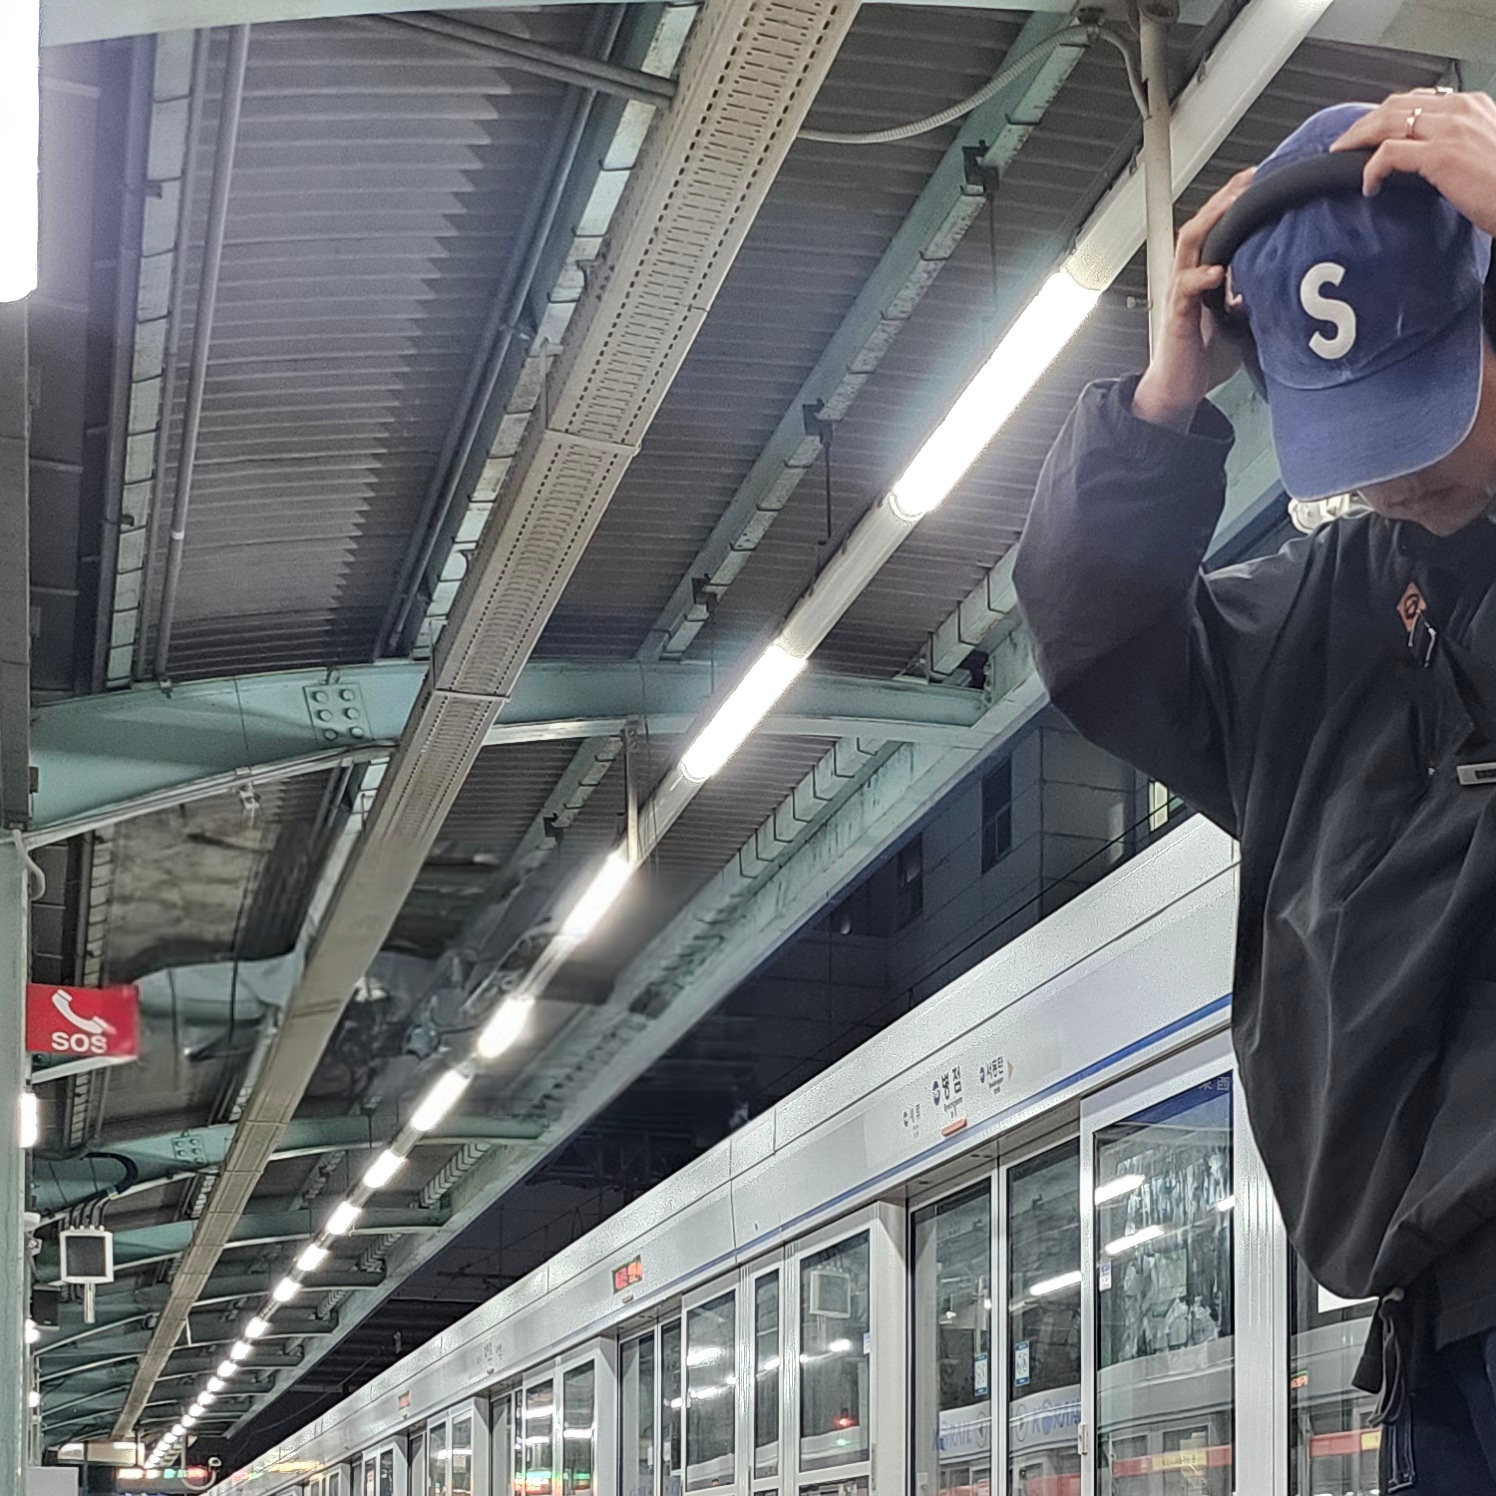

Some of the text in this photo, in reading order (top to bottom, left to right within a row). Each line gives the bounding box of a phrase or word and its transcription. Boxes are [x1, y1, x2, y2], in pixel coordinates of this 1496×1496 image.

[1300, 261, 1357, 360] S
[51, 1031, 108, 1054] SOS
[941, 1065, 963, 1101] 병점
